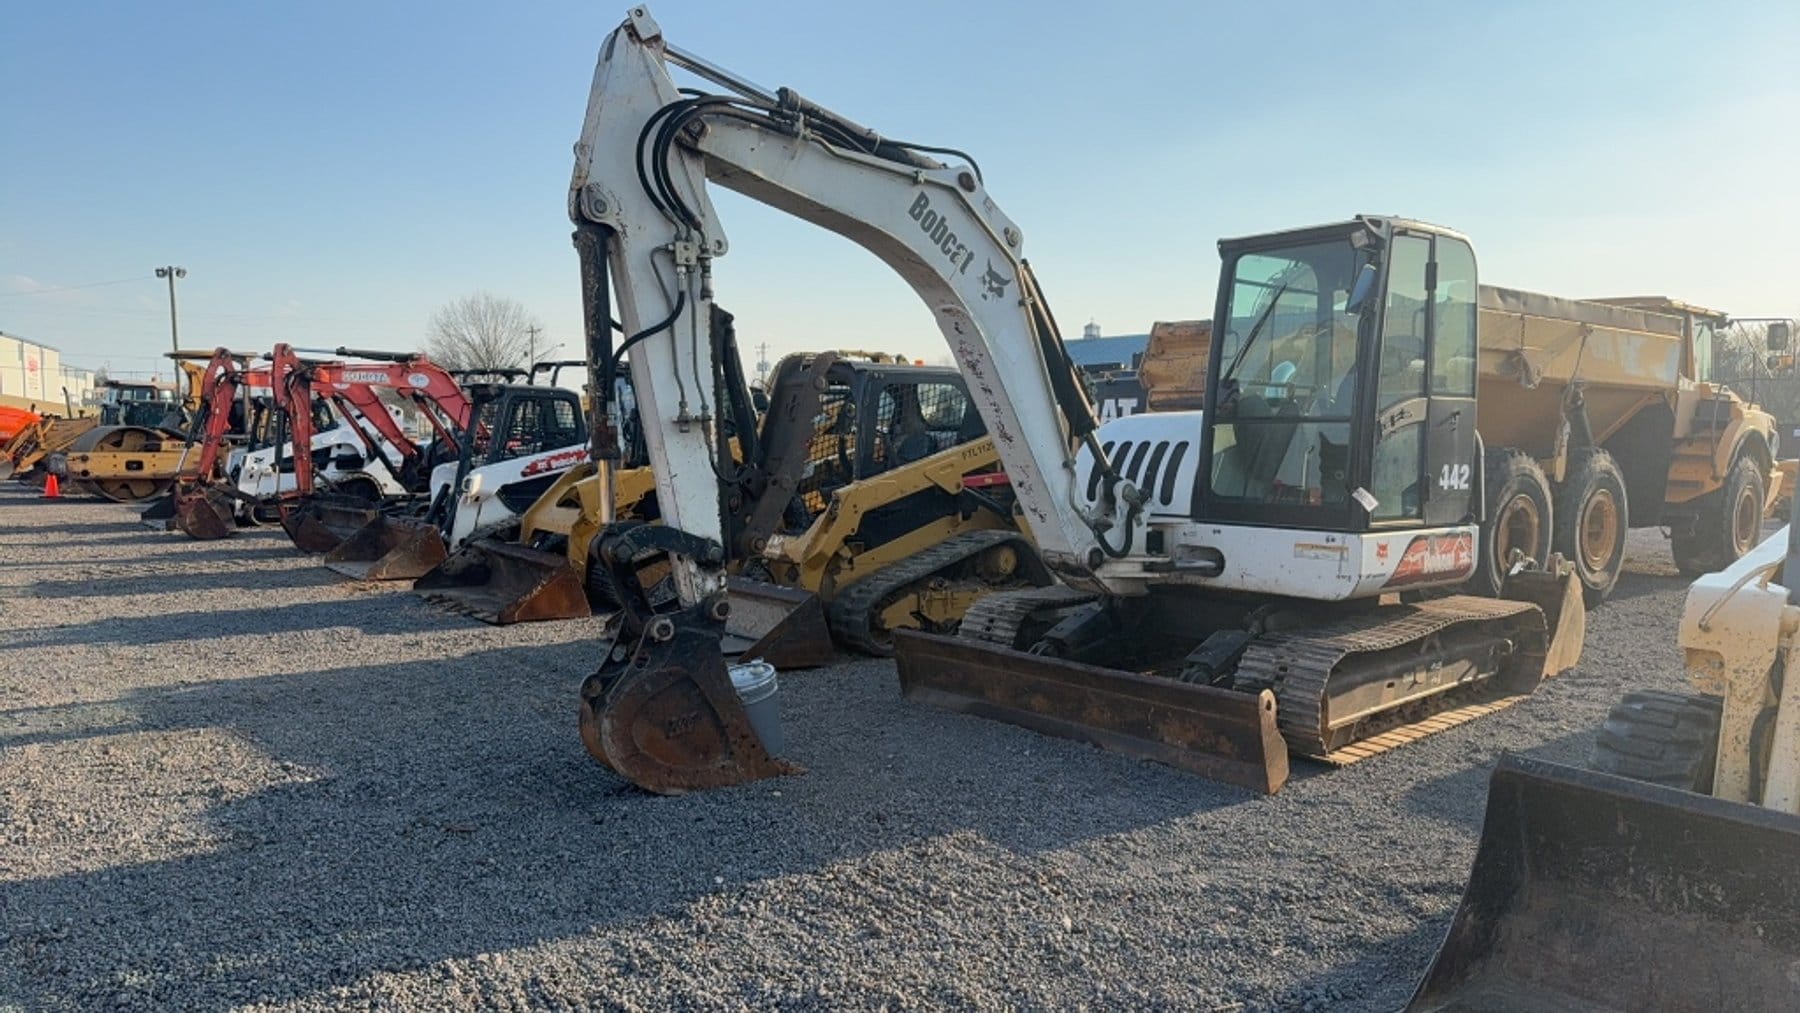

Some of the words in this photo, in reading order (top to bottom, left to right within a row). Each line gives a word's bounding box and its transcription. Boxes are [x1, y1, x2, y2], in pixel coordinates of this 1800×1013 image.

[908, 191, 975, 275] Bobcat
[1092, 398, 1138, 425] AT
[1439, 464, 1470, 490] 442
